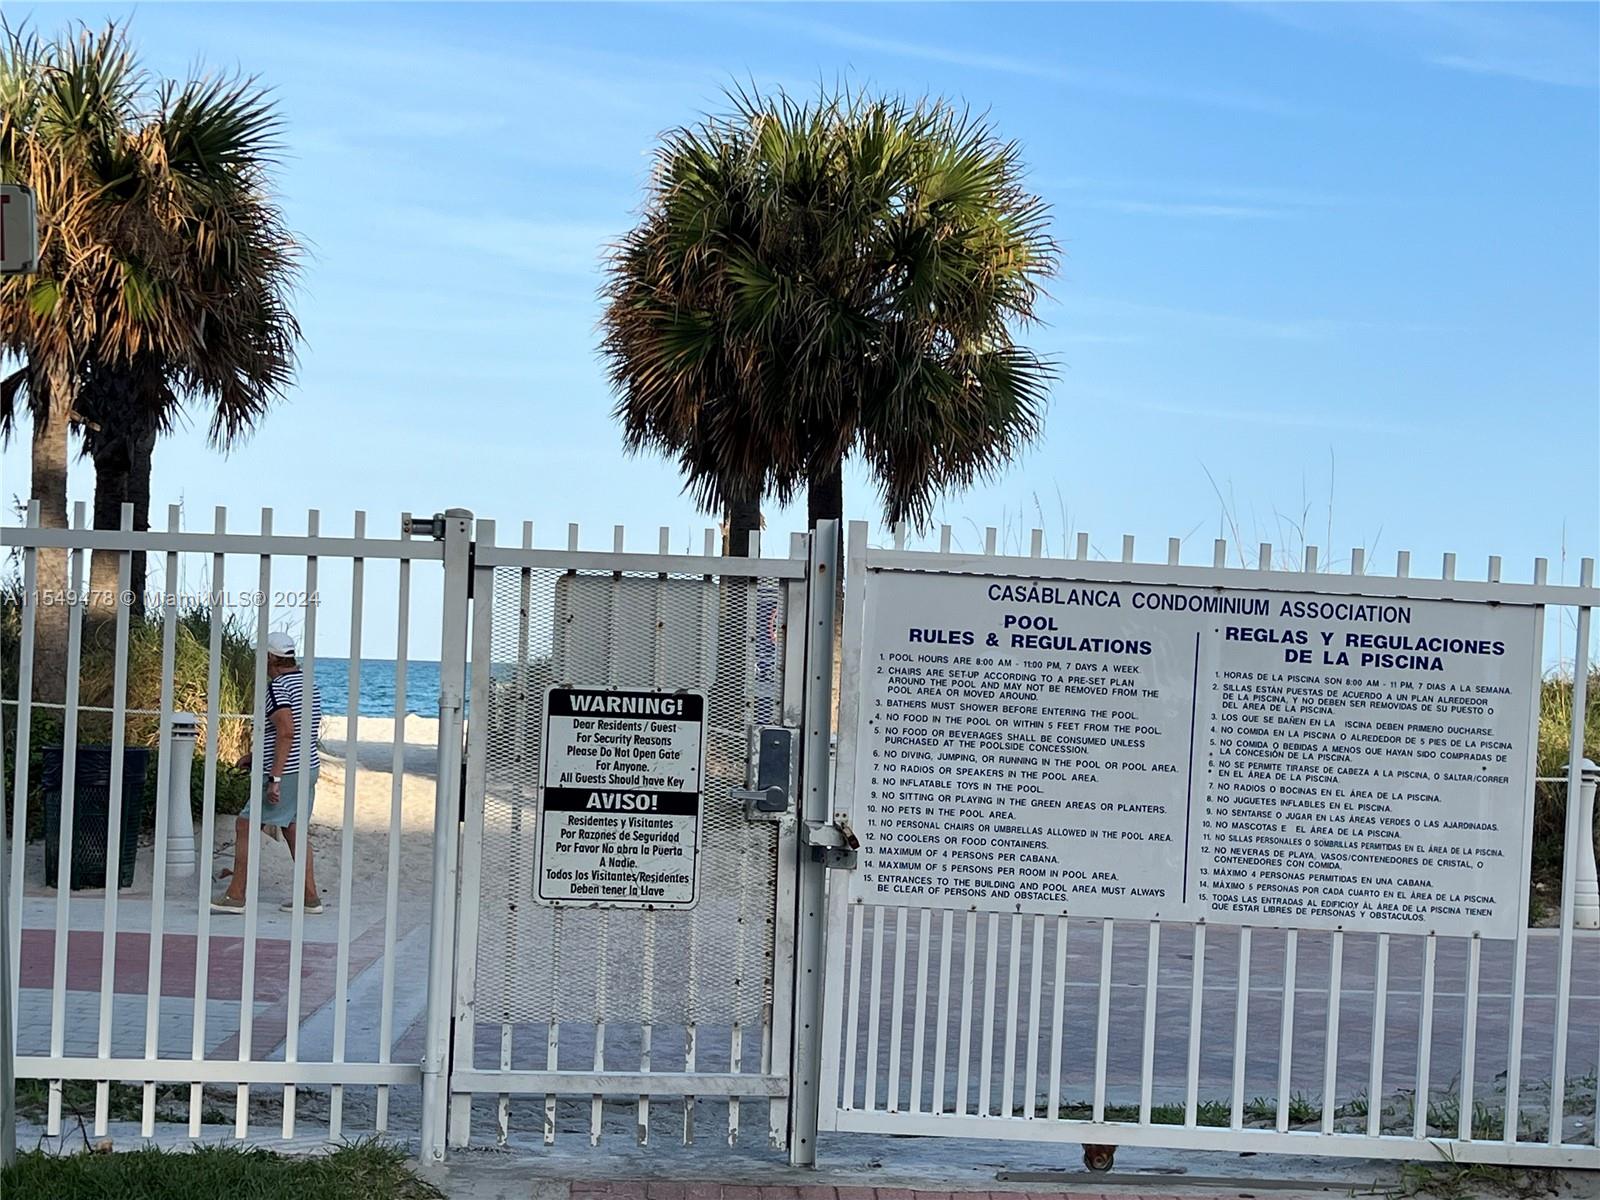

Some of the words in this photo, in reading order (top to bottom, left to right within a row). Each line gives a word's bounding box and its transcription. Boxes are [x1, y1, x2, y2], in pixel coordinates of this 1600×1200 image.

[988, 584, 1121, 607] CASABLANCA
[1132, 592, 1270, 616] CONDOMINIUM
[1280, 601, 1411, 623] ASSOCIATION
[1004, 615, 1058, 631] POOL
[909, 628, 974, 645] RULES
[986, 632, 999, 647] &
[1011, 634, 1152, 655] REGULATIONS
[1226, 626, 1308, 644] REGLAS
[1320, 632, 1334, 646] Y
[1346, 633, 1505, 655] REGULACIONES
[1285, 649, 1312, 664] DE
[1324, 651, 1349, 666] LA
[1361, 653, 1444, 671] PISCINA
[888, 676, 926, 685] AROUND
[930, 678, 947, 687] THE
[951, 679, 976, 688] POOL
[981, 681, 1000, 689] AND
[1003, 682, 1022, 690] MAY
[1026, 684, 1045, 692] NOT
[1049, 684, 1061, 693] BE
[1065, 685, 1108, 695] REMOVED
[1112, 688, 1138, 696] FROM
[1142, 689, 1159, 698] THE
[570, 695, 683, 715] WARNING!
[887, 699, 927, 708] BATHERS
[931, 701, 956, 710] MUST
[960, 703, 998, 712] SHOWER
[1002, 705, 1038, 714] BEFORE
[1042, 707, 1086, 717] ENTERING
[1091, 710, 1107, 718] THE
[1223, 692, 1234, 700] DE
[1292, 696, 1298, 704] Y
[1302, 697, 1314, 705] NO
[1318, 698, 1346, 706] DEBEN
[1350, 700, 1366, 708] SER
[1370, 701, 1418, 711] REMOVIDAS
[1436, 704, 1448, 712] SU
[1451, 705, 1484, 714] PUESTO
[573, 718, 596, 729] Dear
[598, 719, 642, 731] Residents
[650, 721, 677, 733] Guest
[576, 732, 592, 742] For
[594, 732, 632, 746] Security
[634, 734, 672, 746] Reasons
[567, 745, 598, 756] Please
[600, 746, 612, 757] Do
[614, 747, 630, 758] Not
[633, 748, 656, 760] Open
[659, 748, 680, 760] Gate
[884, 750, 897, 758] NO
[982, 755, 995, 763] OR
[999, 756, 1038, 765] RUNNING
[1042, 758, 1050, 766] IN
[1054, 759, 1072, 767] THE
[1076, 760, 1100, 768] POOL
[1105, 761, 1118, 769] OR
[1122, 762, 1147, 771] POOL
[1302, 752, 1314, 760] LA
[596, 760, 611, 770] For
[613, 760, 650, 774] Anyone.
[560, 772, 573, 782] All
[575, 772, 606, 784] Guests
[609, 773, 640, 785] Should
[642, 775, 665, 787] have
[667, 776, 684, 789] Key
[586, 792, 658, 810] AVISO!
[882, 791, 895, 799] NO
[899, 792, 934, 801] SITTING
[938, 794, 951, 802] OR
[955, 795, 993, 804] PLAYING
[1010, 798, 1026, 806] THE
[1031, 799, 1061, 808] GREEN
[1065, 801, 1096, 810] AREAS
[1100, 803, 1113, 811] OR
[1118, 804, 1167, 814] PLANTERS.
[1217, 795, 1230, 803] NO
[1233, 797, 1277, 806] JUGUETES
[1280, 799, 1326, 809] INFLABLES
[1344, 802, 1354, 810] EL
[568, 815, 618, 827] Residentes
[620, 819, 626, 829] y
[629, 817, 674, 828] Visitantes
[1216, 808, 1228, 816] NO
[1232, 809, 1272, 818] SENTARSE
[1285, 812, 1312, 820] JUGAR
[1380, 818, 1411, 826] VERDES
[1424, 820, 1439, 828] LAS
[560, 828, 577, 839] Por
[578, 829, 617, 840] Razones
[619, 830, 631, 840] de
[632, 830, 680, 844] Seguridad
[556, 842, 572, 852] Por
[574, 842, 600, 853] Favor
[602, 843, 614, 853] No
[617, 844, 638, 854] abra
[641, 844, 650, 855] la
[652, 845, 683, 856] Puerta
[599, 856, 606, 867] A
[609, 856, 638, 868] Nadie.
[546, 869, 573, 880] Todos
[575, 870, 589, 880] los
[570, 883, 599, 894] Deben
[601, 885, 627, 894] tener
[629, 884, 638, 894] la
[640, 885, 665, 896] Llave
[877, 884, 889, 892] BE
[894, 884, 924, 894] CLEAR
[928, 886, 940, 894] OF
[944, 887, 987, 897] PERSONS
[991, 890, 1010, 898] AND
[1212, 902, 1229, 910] QUE
[1233, 904, 1260, 912] ESTAR
[1263, 906, 1292, 914] LIBRES
[1296, 907, 1307, 915] DE
[1311, 908, 1356, 918] PERSONAS
